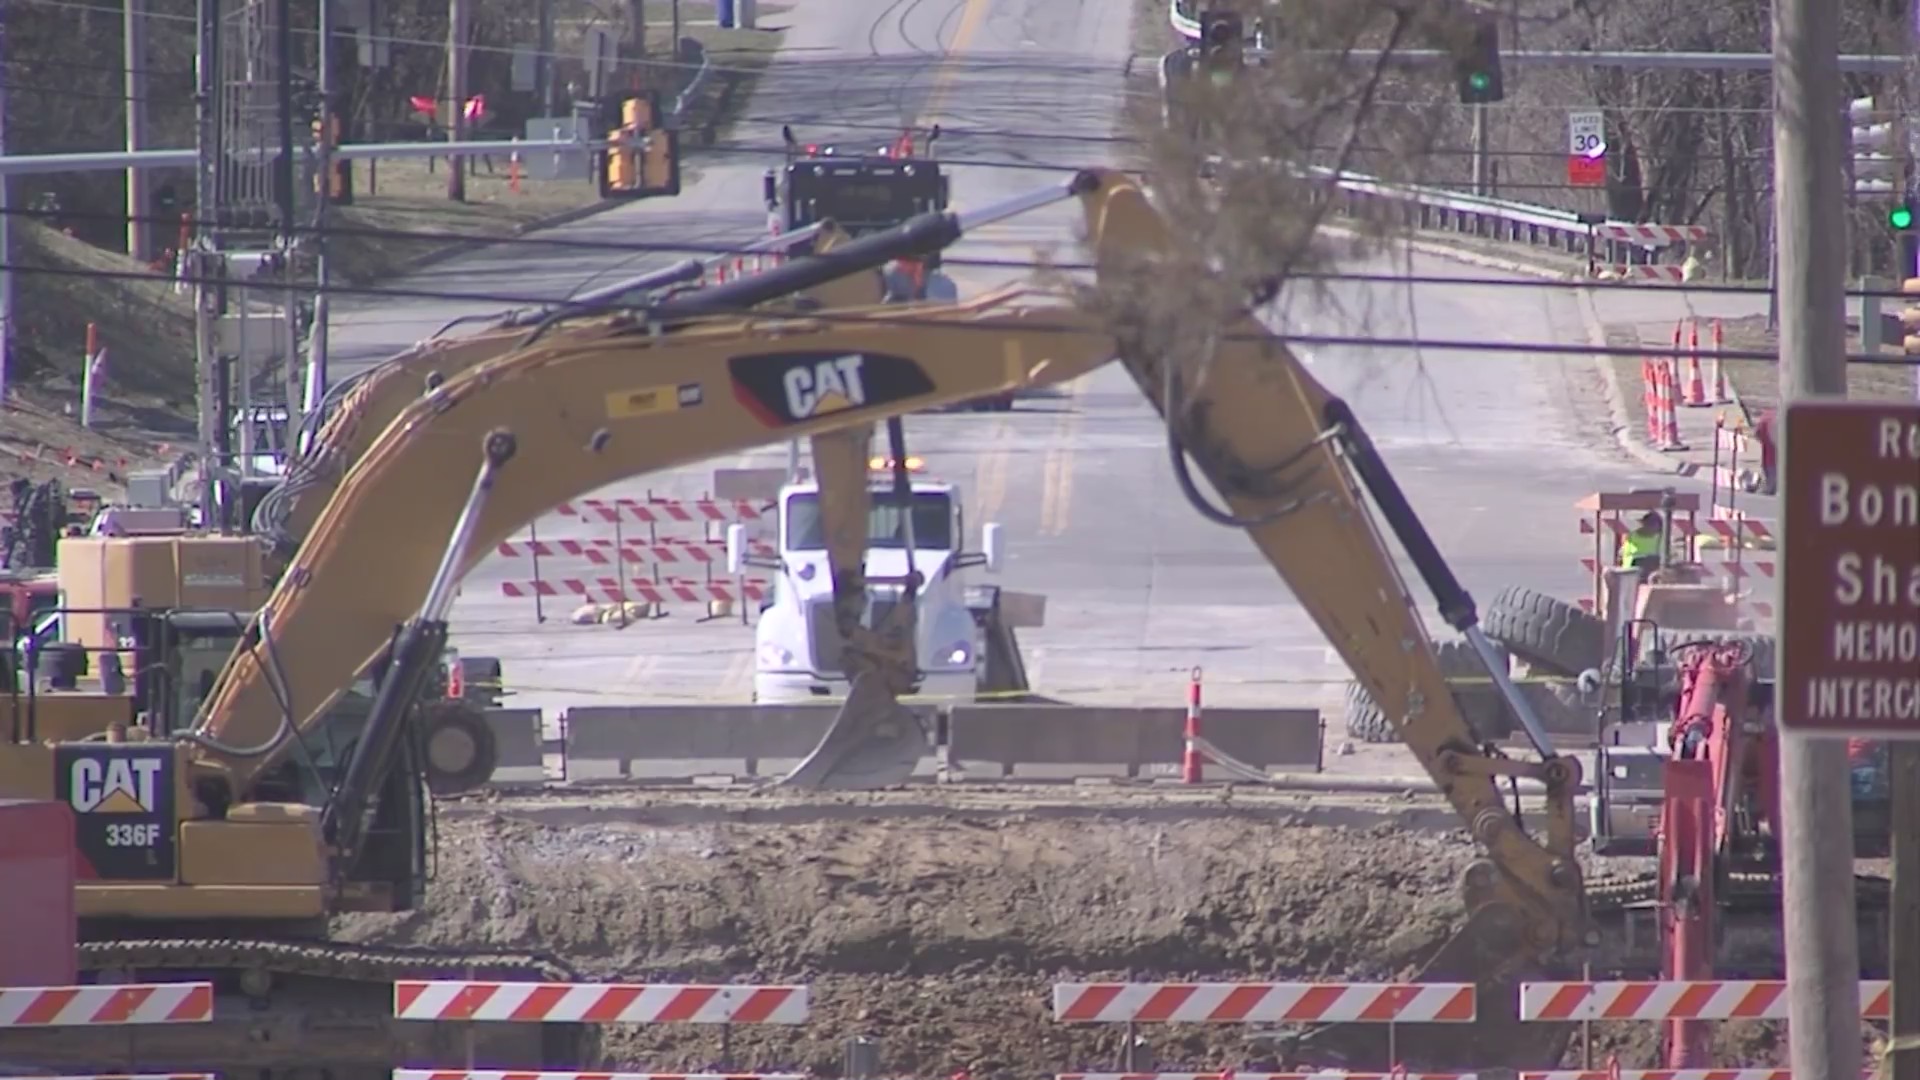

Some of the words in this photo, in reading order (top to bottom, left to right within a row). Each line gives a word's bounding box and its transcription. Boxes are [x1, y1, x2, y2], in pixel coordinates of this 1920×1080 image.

[1575, 134, 1600, 151] 30
[783, 354, 864, 418] CAT
[1821, 472, 1918, 526] Bon
[71, 758, 162, 812] CAT
[105, 823, 160, 847] 336F
